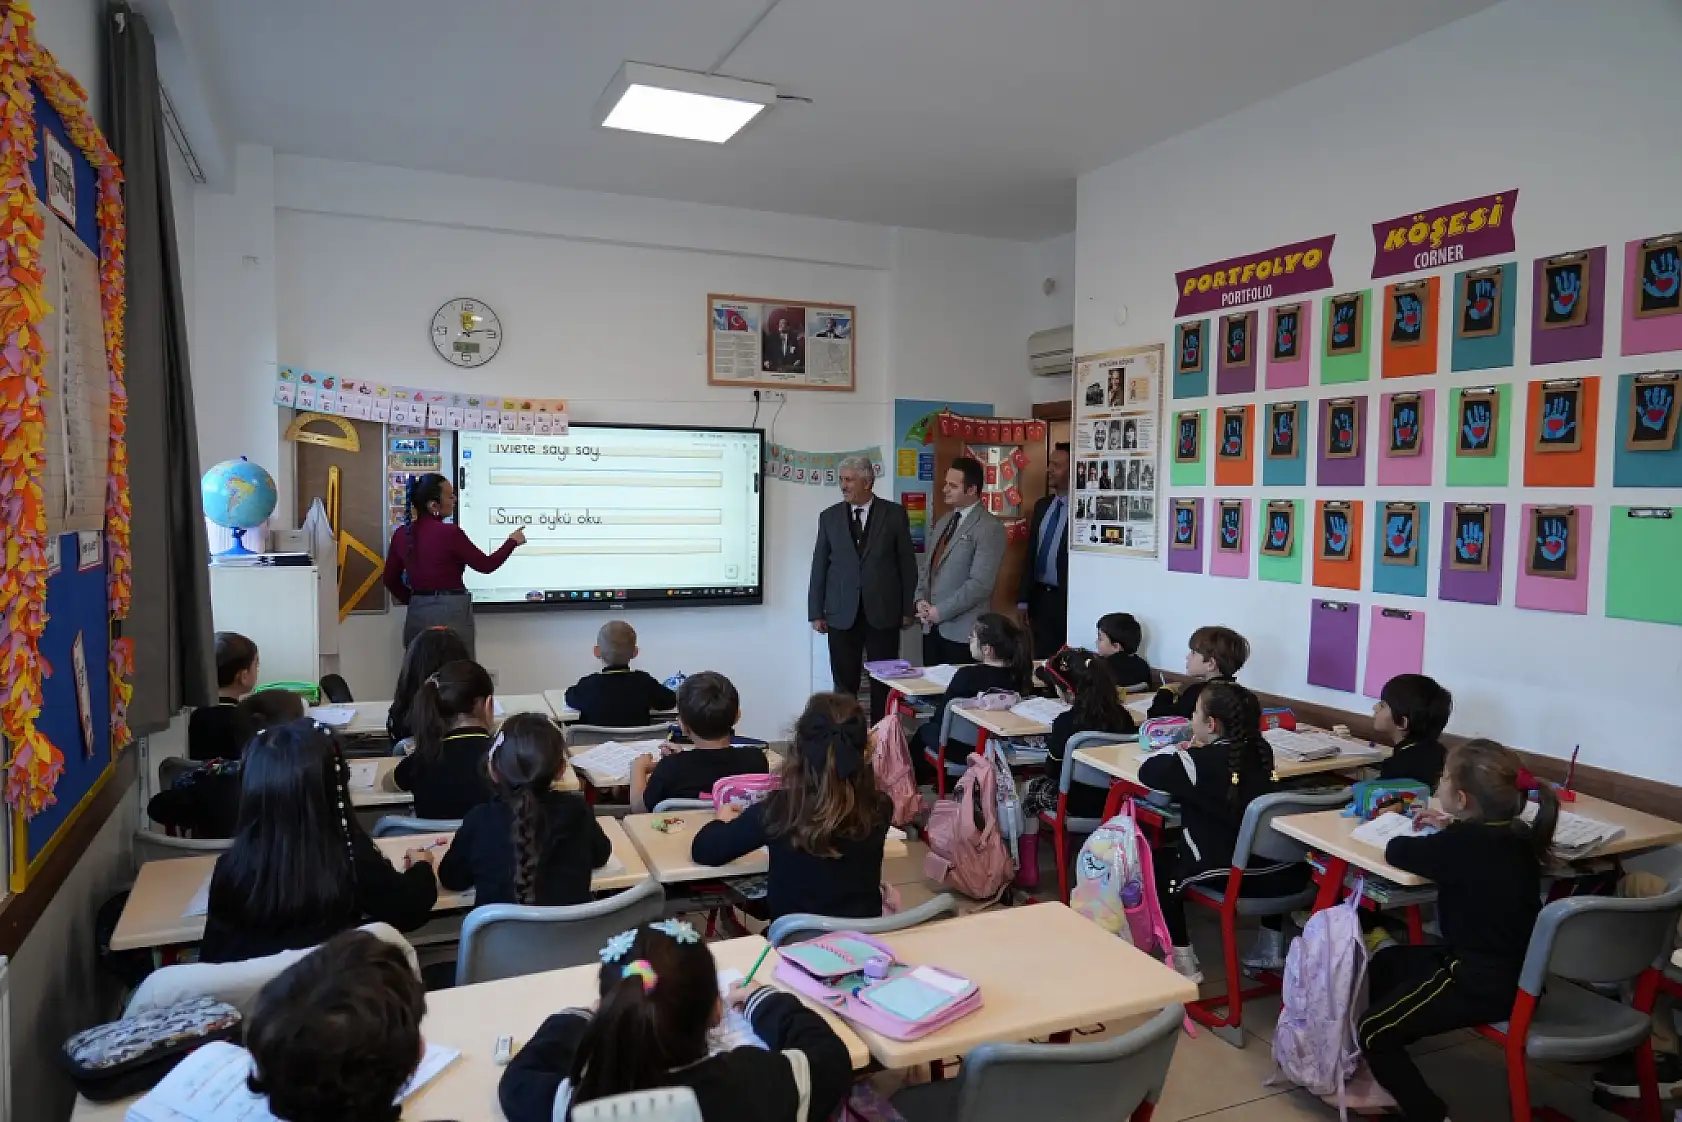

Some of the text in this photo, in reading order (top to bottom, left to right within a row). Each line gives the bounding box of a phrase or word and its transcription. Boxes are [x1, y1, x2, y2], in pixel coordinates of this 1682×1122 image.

[1384, 196, 1504, 251] KÖŞESİ
[1414, 244, 1464, 269] CORNER
[1183, 248, 1323, 296] PORTFOLYO
[1221, 284, 1272, 307] PORTFOLIO
[782, 466, 790, 478] 2
[796, 469, 804, 480] 3
[811, 470, 819, 481] 4
[827, 470, 833, 481] 5
[496, 508, 603, 530] Suna öykü oku.
